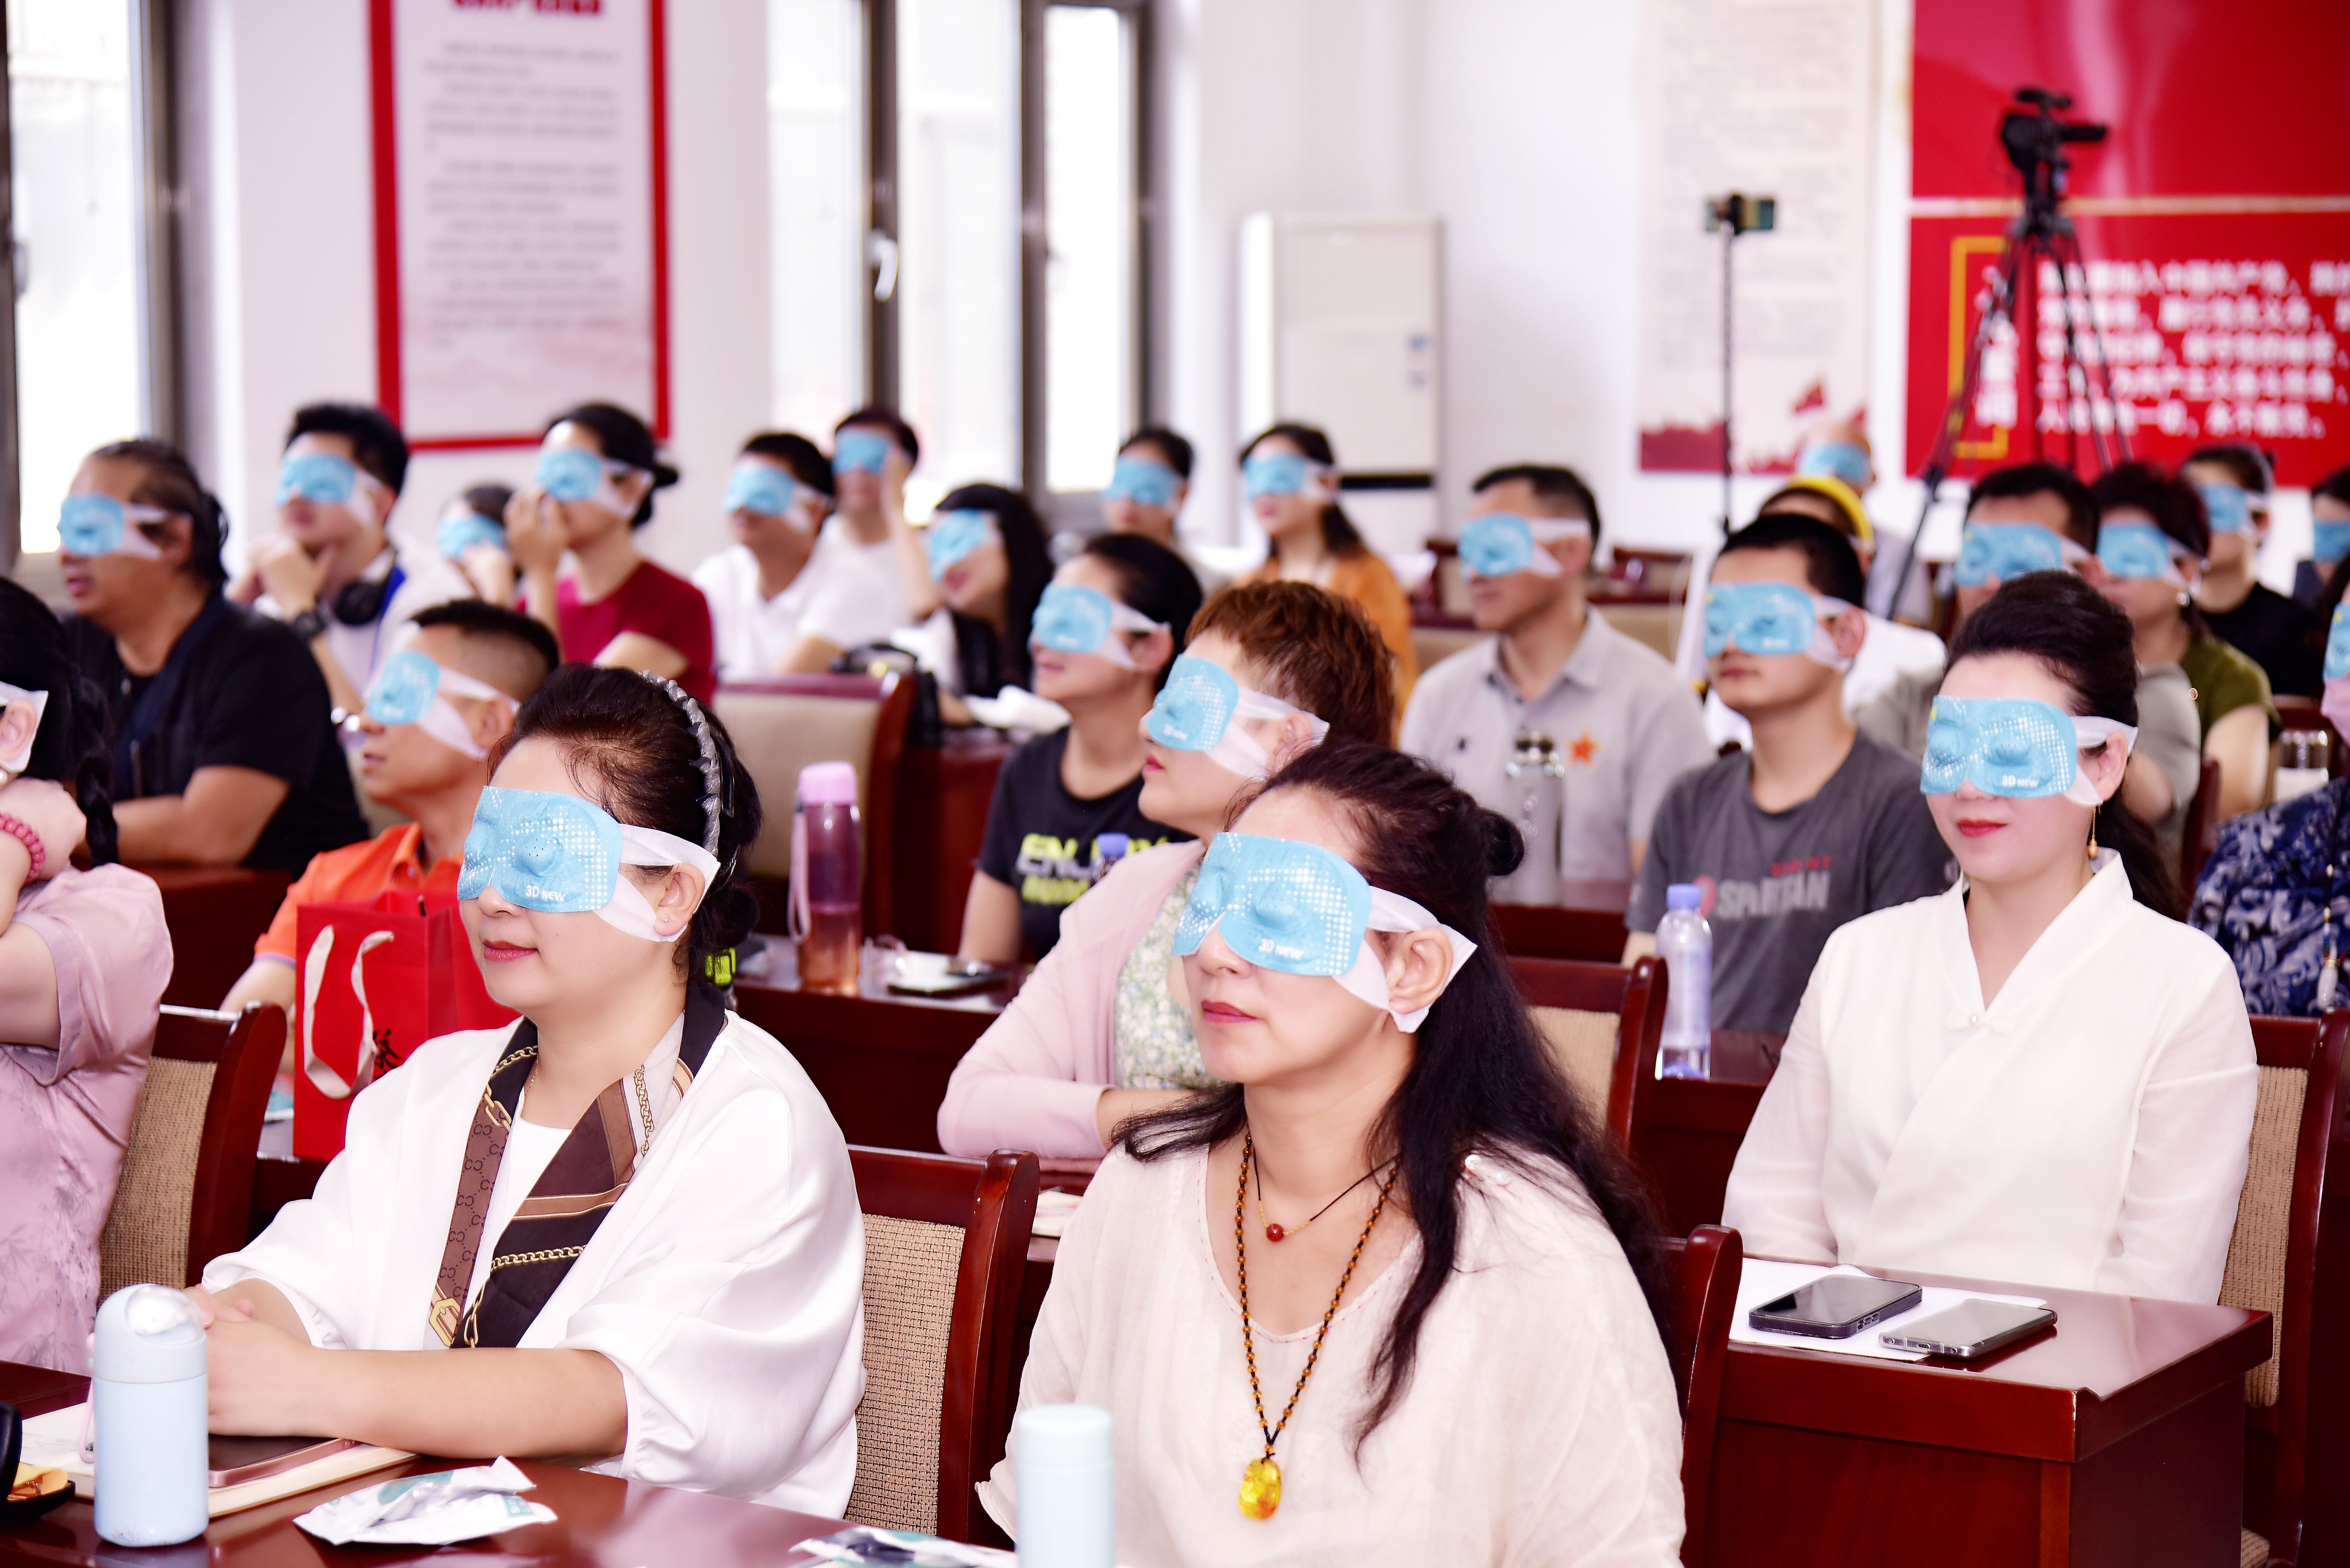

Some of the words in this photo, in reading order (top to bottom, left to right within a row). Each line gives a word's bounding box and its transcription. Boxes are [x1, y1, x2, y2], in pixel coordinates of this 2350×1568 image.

[2002, 774, 2016, 787] 3D
[2017, 778, 2039, 789] NEW
[525, 885, 539, 897] 3D
[542, 890, 567, 902] NEW
[1258, 938, 1275, 952] 3D
[1275, 944, 1304, 961] NEW
